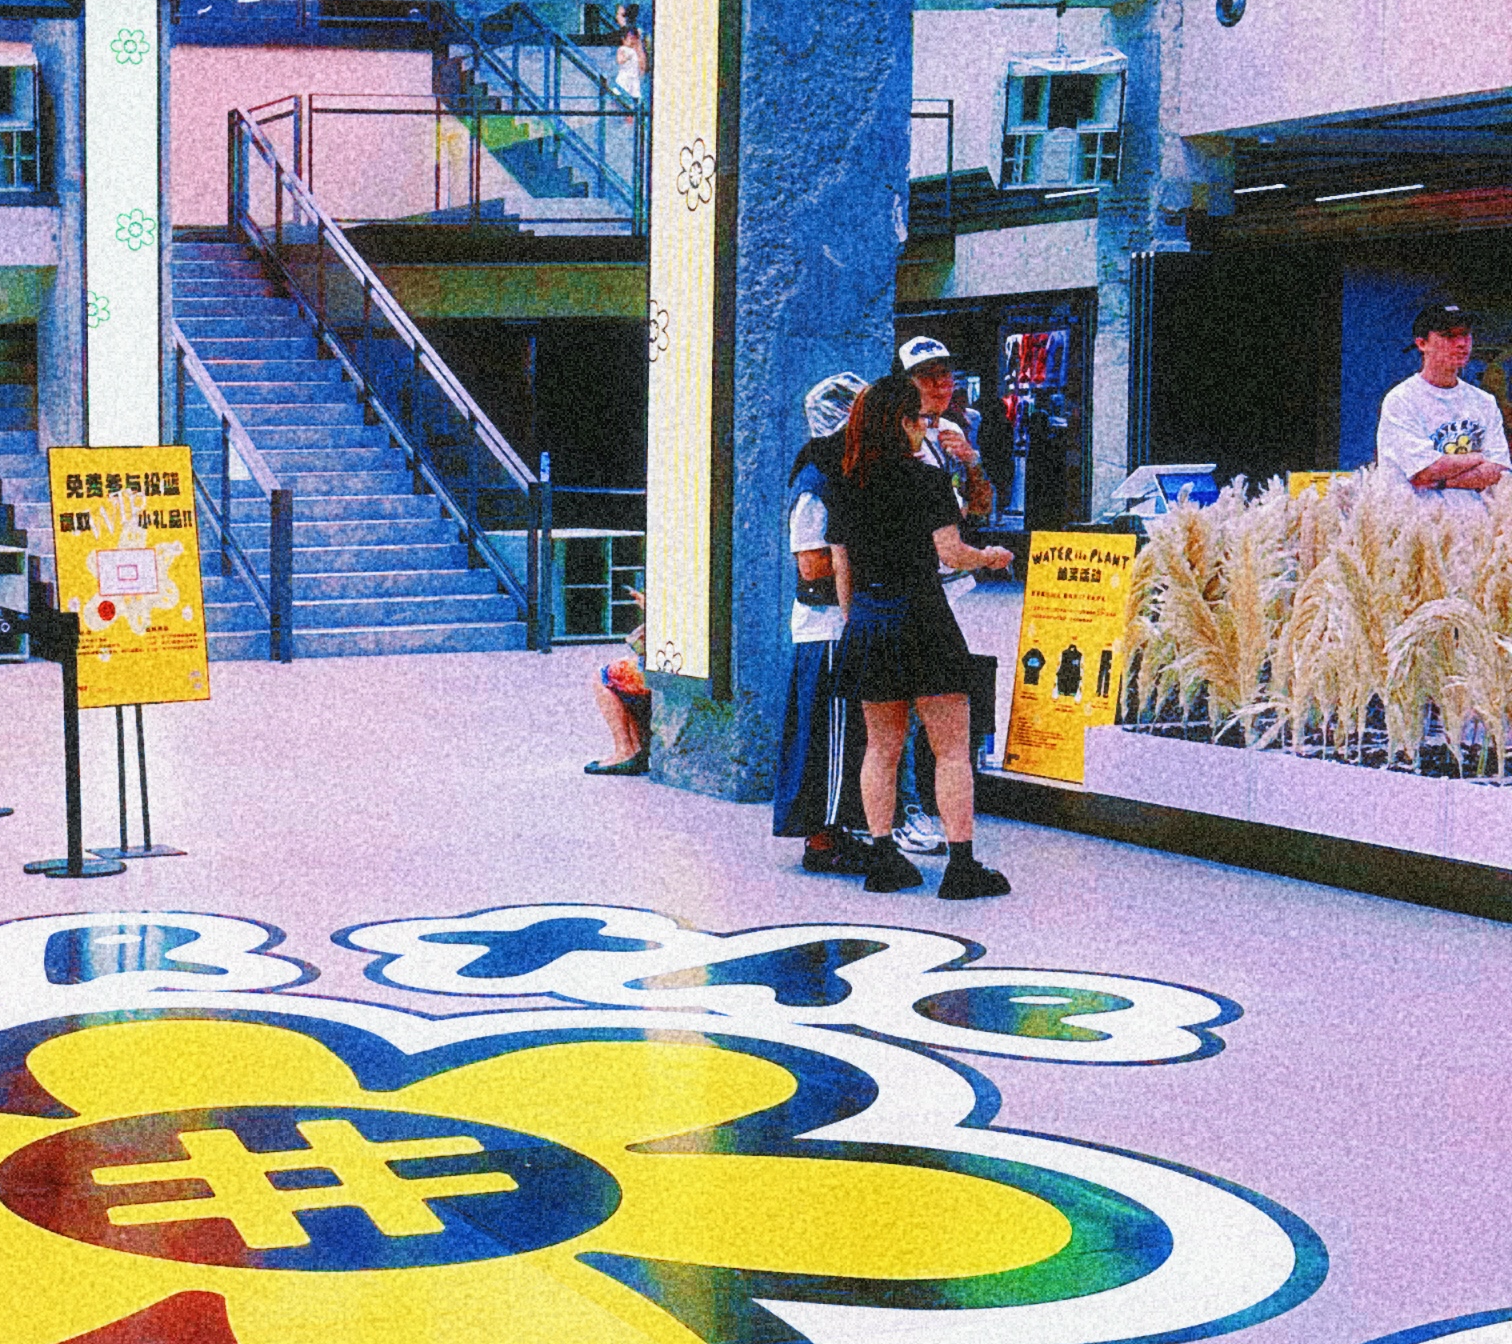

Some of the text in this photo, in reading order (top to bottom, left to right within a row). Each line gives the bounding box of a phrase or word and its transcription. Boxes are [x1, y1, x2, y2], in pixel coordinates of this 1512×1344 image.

[66, 472, 180, 498] 免费参与投篮
[1032, 546, 1073, 565] WATER
[1090, 548, 1130, 570] PLANT
